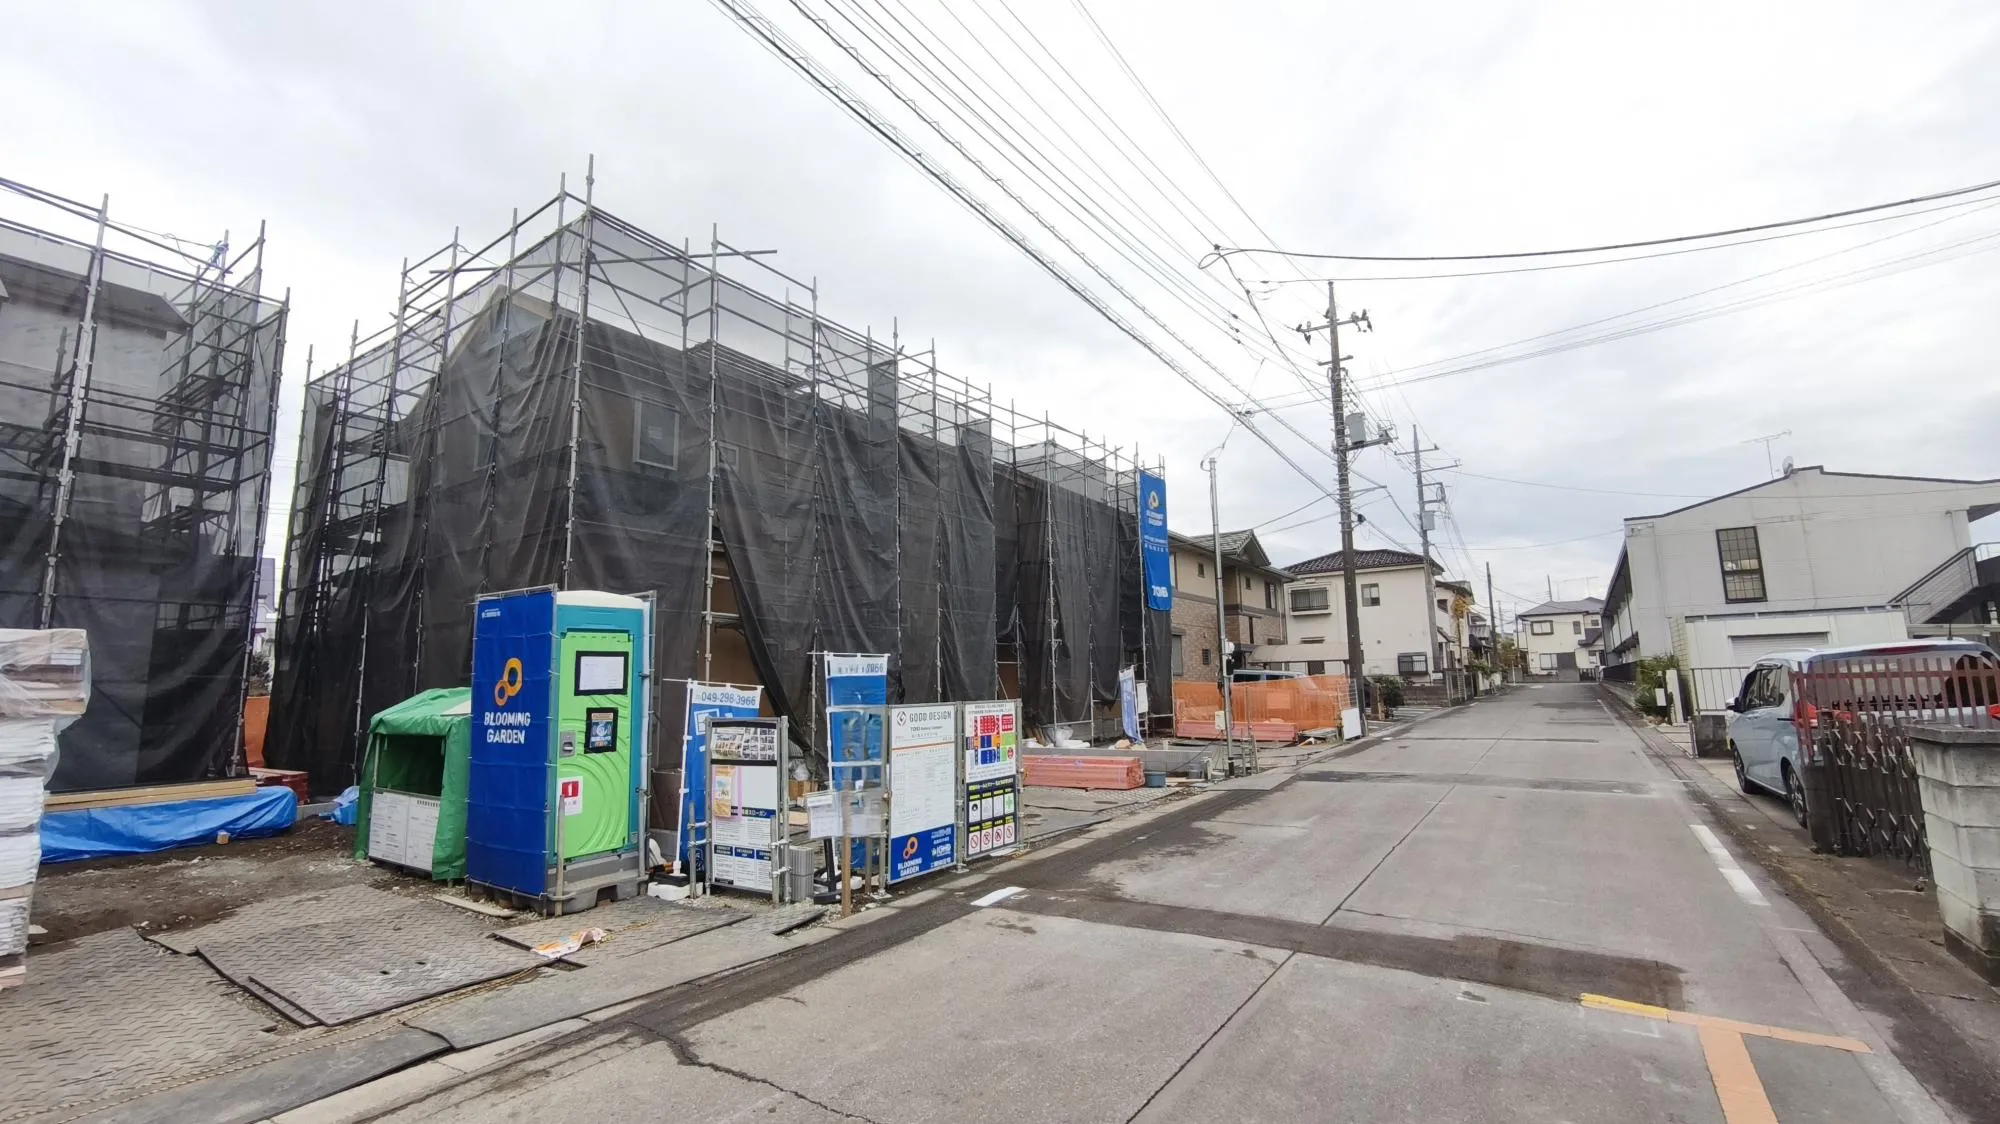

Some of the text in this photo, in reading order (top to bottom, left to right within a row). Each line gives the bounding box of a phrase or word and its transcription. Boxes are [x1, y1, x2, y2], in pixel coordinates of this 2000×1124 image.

[484, 711, 531, 727] BLOOMING
[909, 710, 952, 722] GOOD DESIGN
[486, 728, 526, 744] GARDEN
